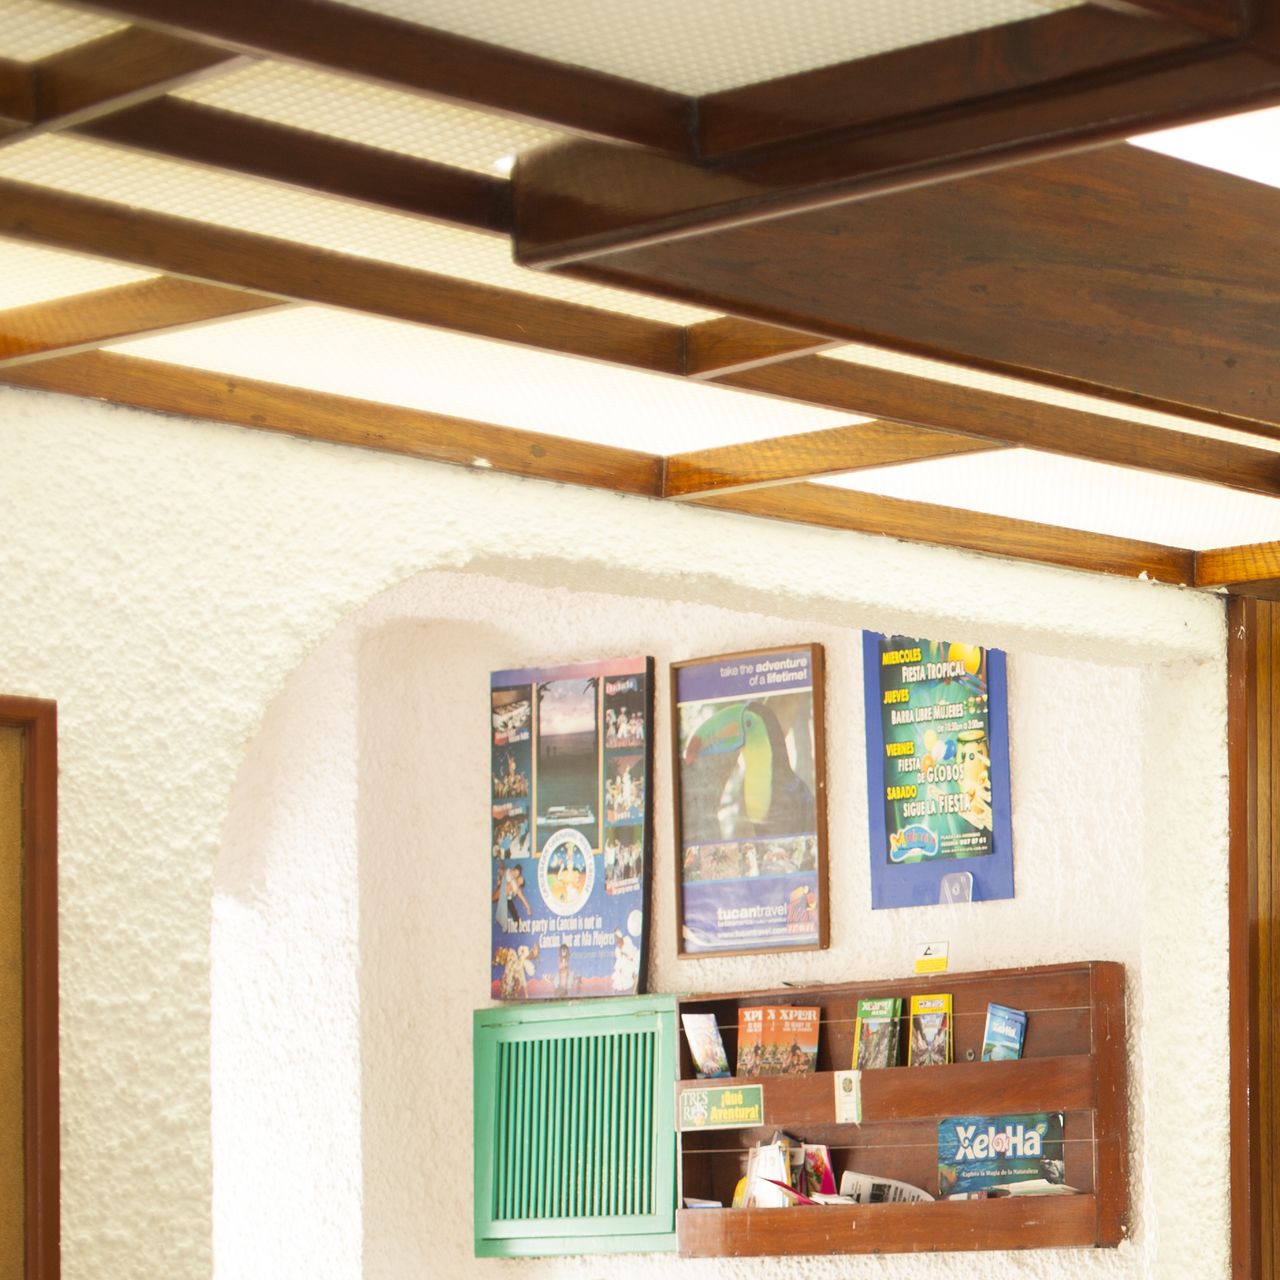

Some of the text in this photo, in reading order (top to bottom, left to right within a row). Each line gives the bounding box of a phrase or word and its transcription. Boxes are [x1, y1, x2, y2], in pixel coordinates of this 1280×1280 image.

[882, 648, 921, 665] MIERCOLES
[720, 658, 807, 677] take the adventure
[902, 661, 965, 683] FIESTA TROPICAL
[749, 670, 807, 686] of a lifetime!
[884, 689, 909, 704] JUEVES
[891, 704, 963, 725] BARRA LIBRE MUJERES
[886, 742, 915, 757] VIERNES
[898, 758, 920, 772] FIESTA
[927, 764, 964, 784] GLOBOS
[887, 785, 917, 800] SABADO
[903, 794, 971, 818] SIGUE LA FIESTA
[717, 902, 787, 920] tucantravel
[532, 918, 548, 934] party
[683, 1091, 708, 1105] TRES
[710, 1104, 758, 1121] Aventura!
